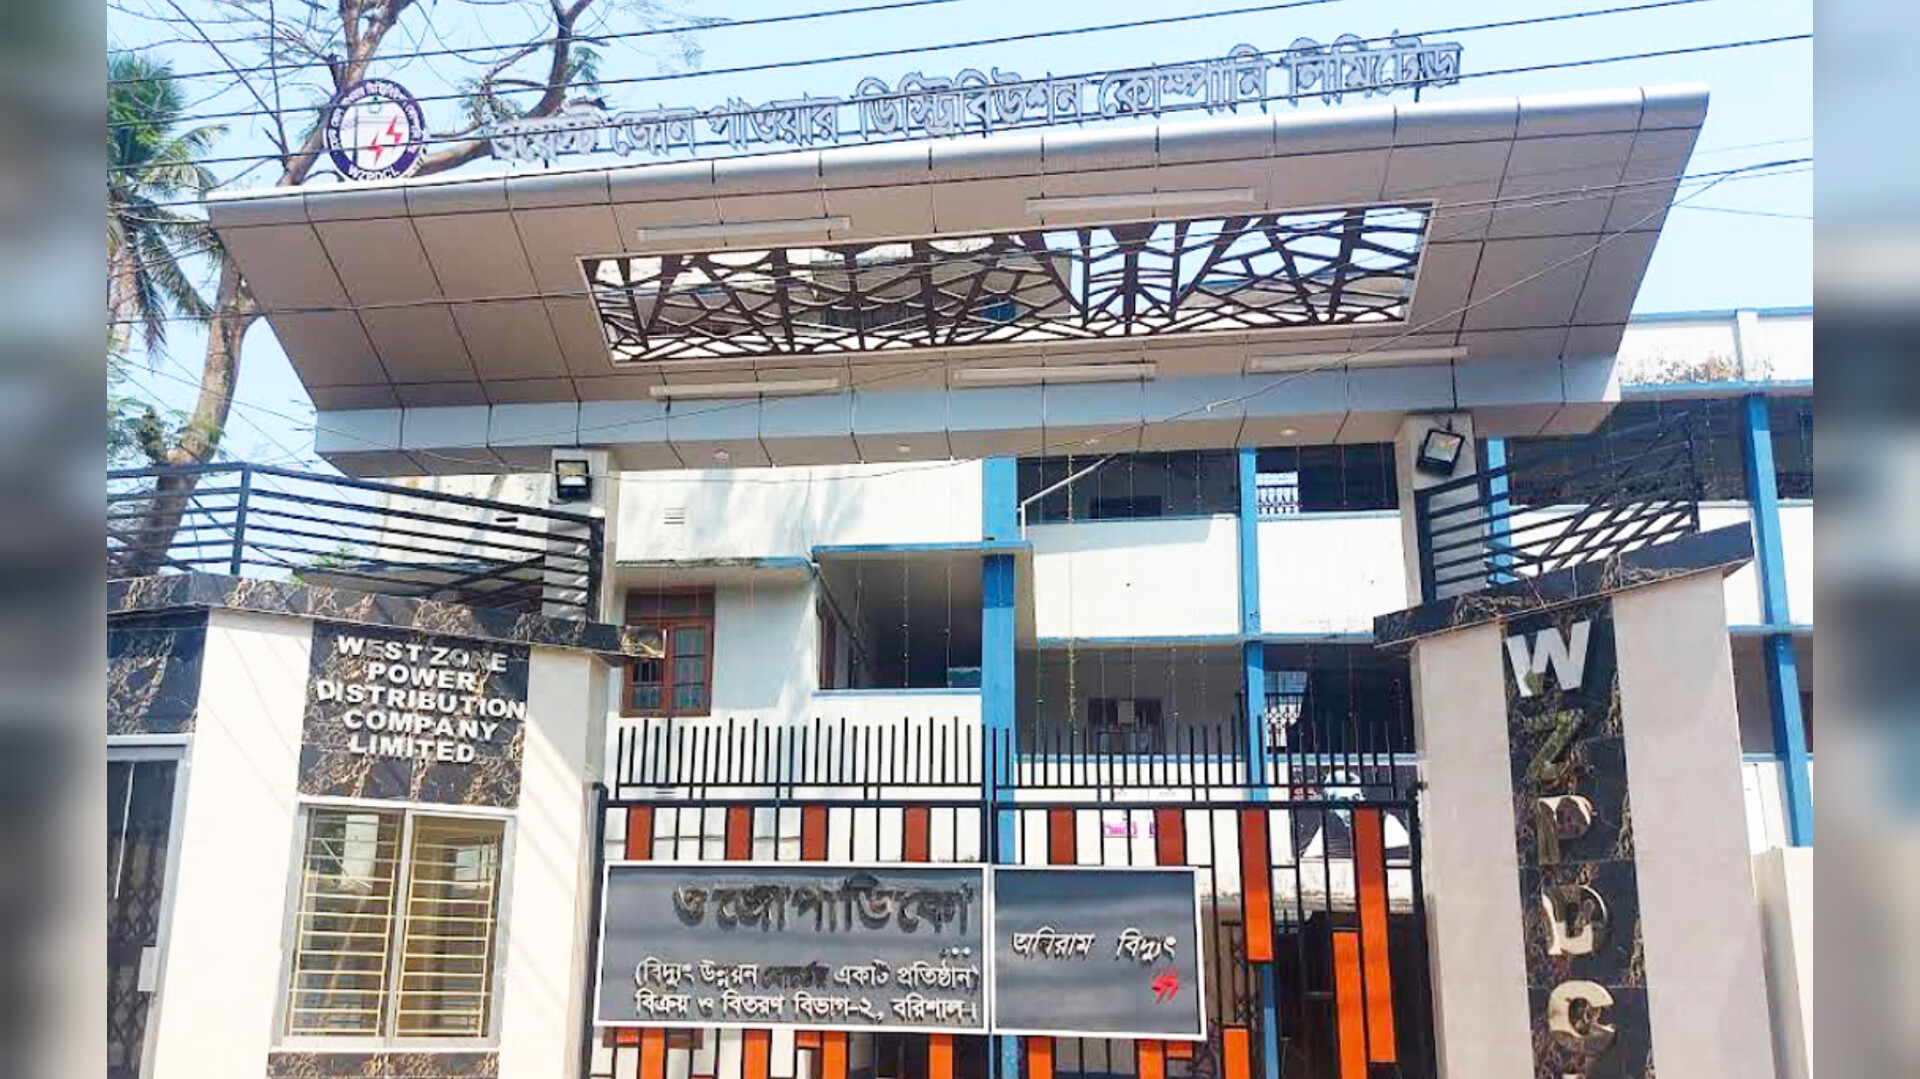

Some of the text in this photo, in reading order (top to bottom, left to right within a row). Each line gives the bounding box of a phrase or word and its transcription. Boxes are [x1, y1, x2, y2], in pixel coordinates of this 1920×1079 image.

[610, 103, 700, 157] জোন
[707, 92, 843, 148] পাওয়ার
[1097, 42, 1270, 119] কোম্পানি
[336, 634, 509, 673] WEST ZONE
[367, 661, 475, 693] POWER
[315, 679, 527, 721] DISTRIBUTION
[343, 708, 499, 742] COMPANY
[349, 734, 476, 764] LIMITED
[721, 988, 786, 1018] বিতরণ
